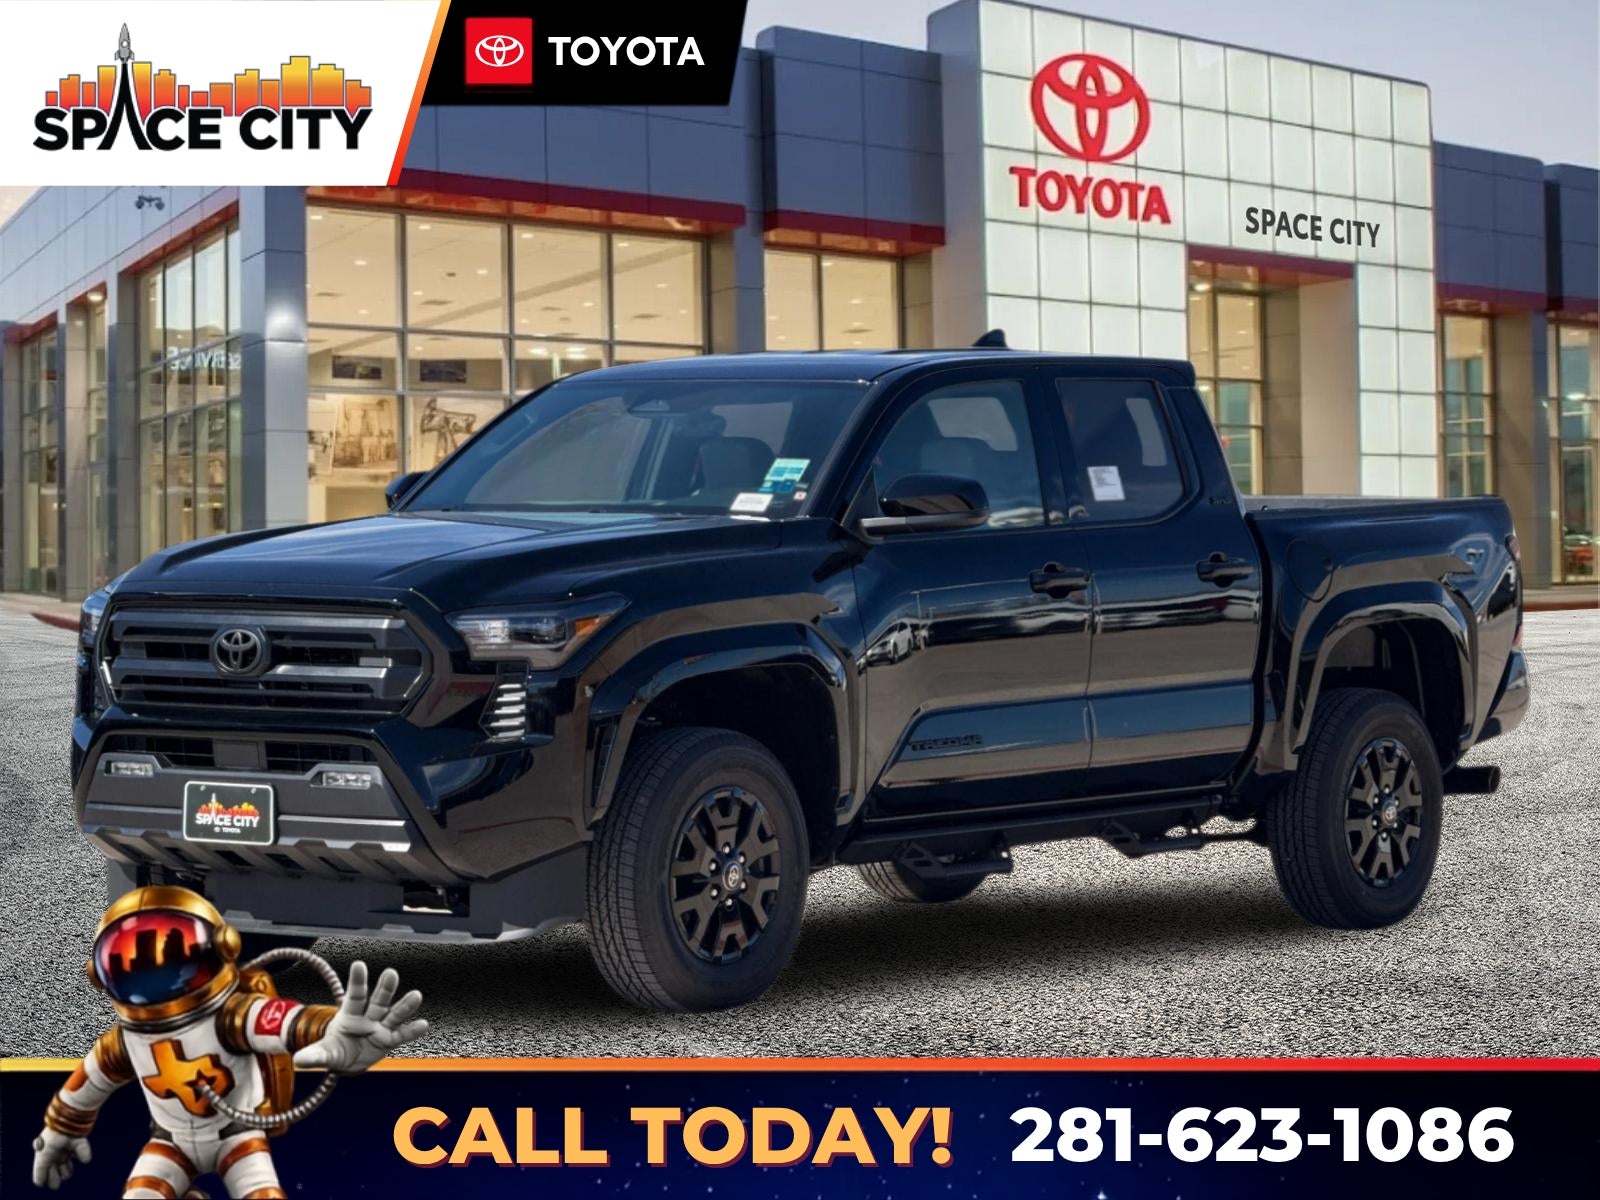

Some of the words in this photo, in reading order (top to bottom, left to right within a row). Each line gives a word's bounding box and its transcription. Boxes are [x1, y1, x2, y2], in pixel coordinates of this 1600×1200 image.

[1010, 166, 1171, 224] TOYOTA
[1245, 206, 1323, 242] SPACE
[1329, 219, 1380, 248] CITY
[195, 812, 232, 826] SPACE
[233, 815, 260, 828] CITY
